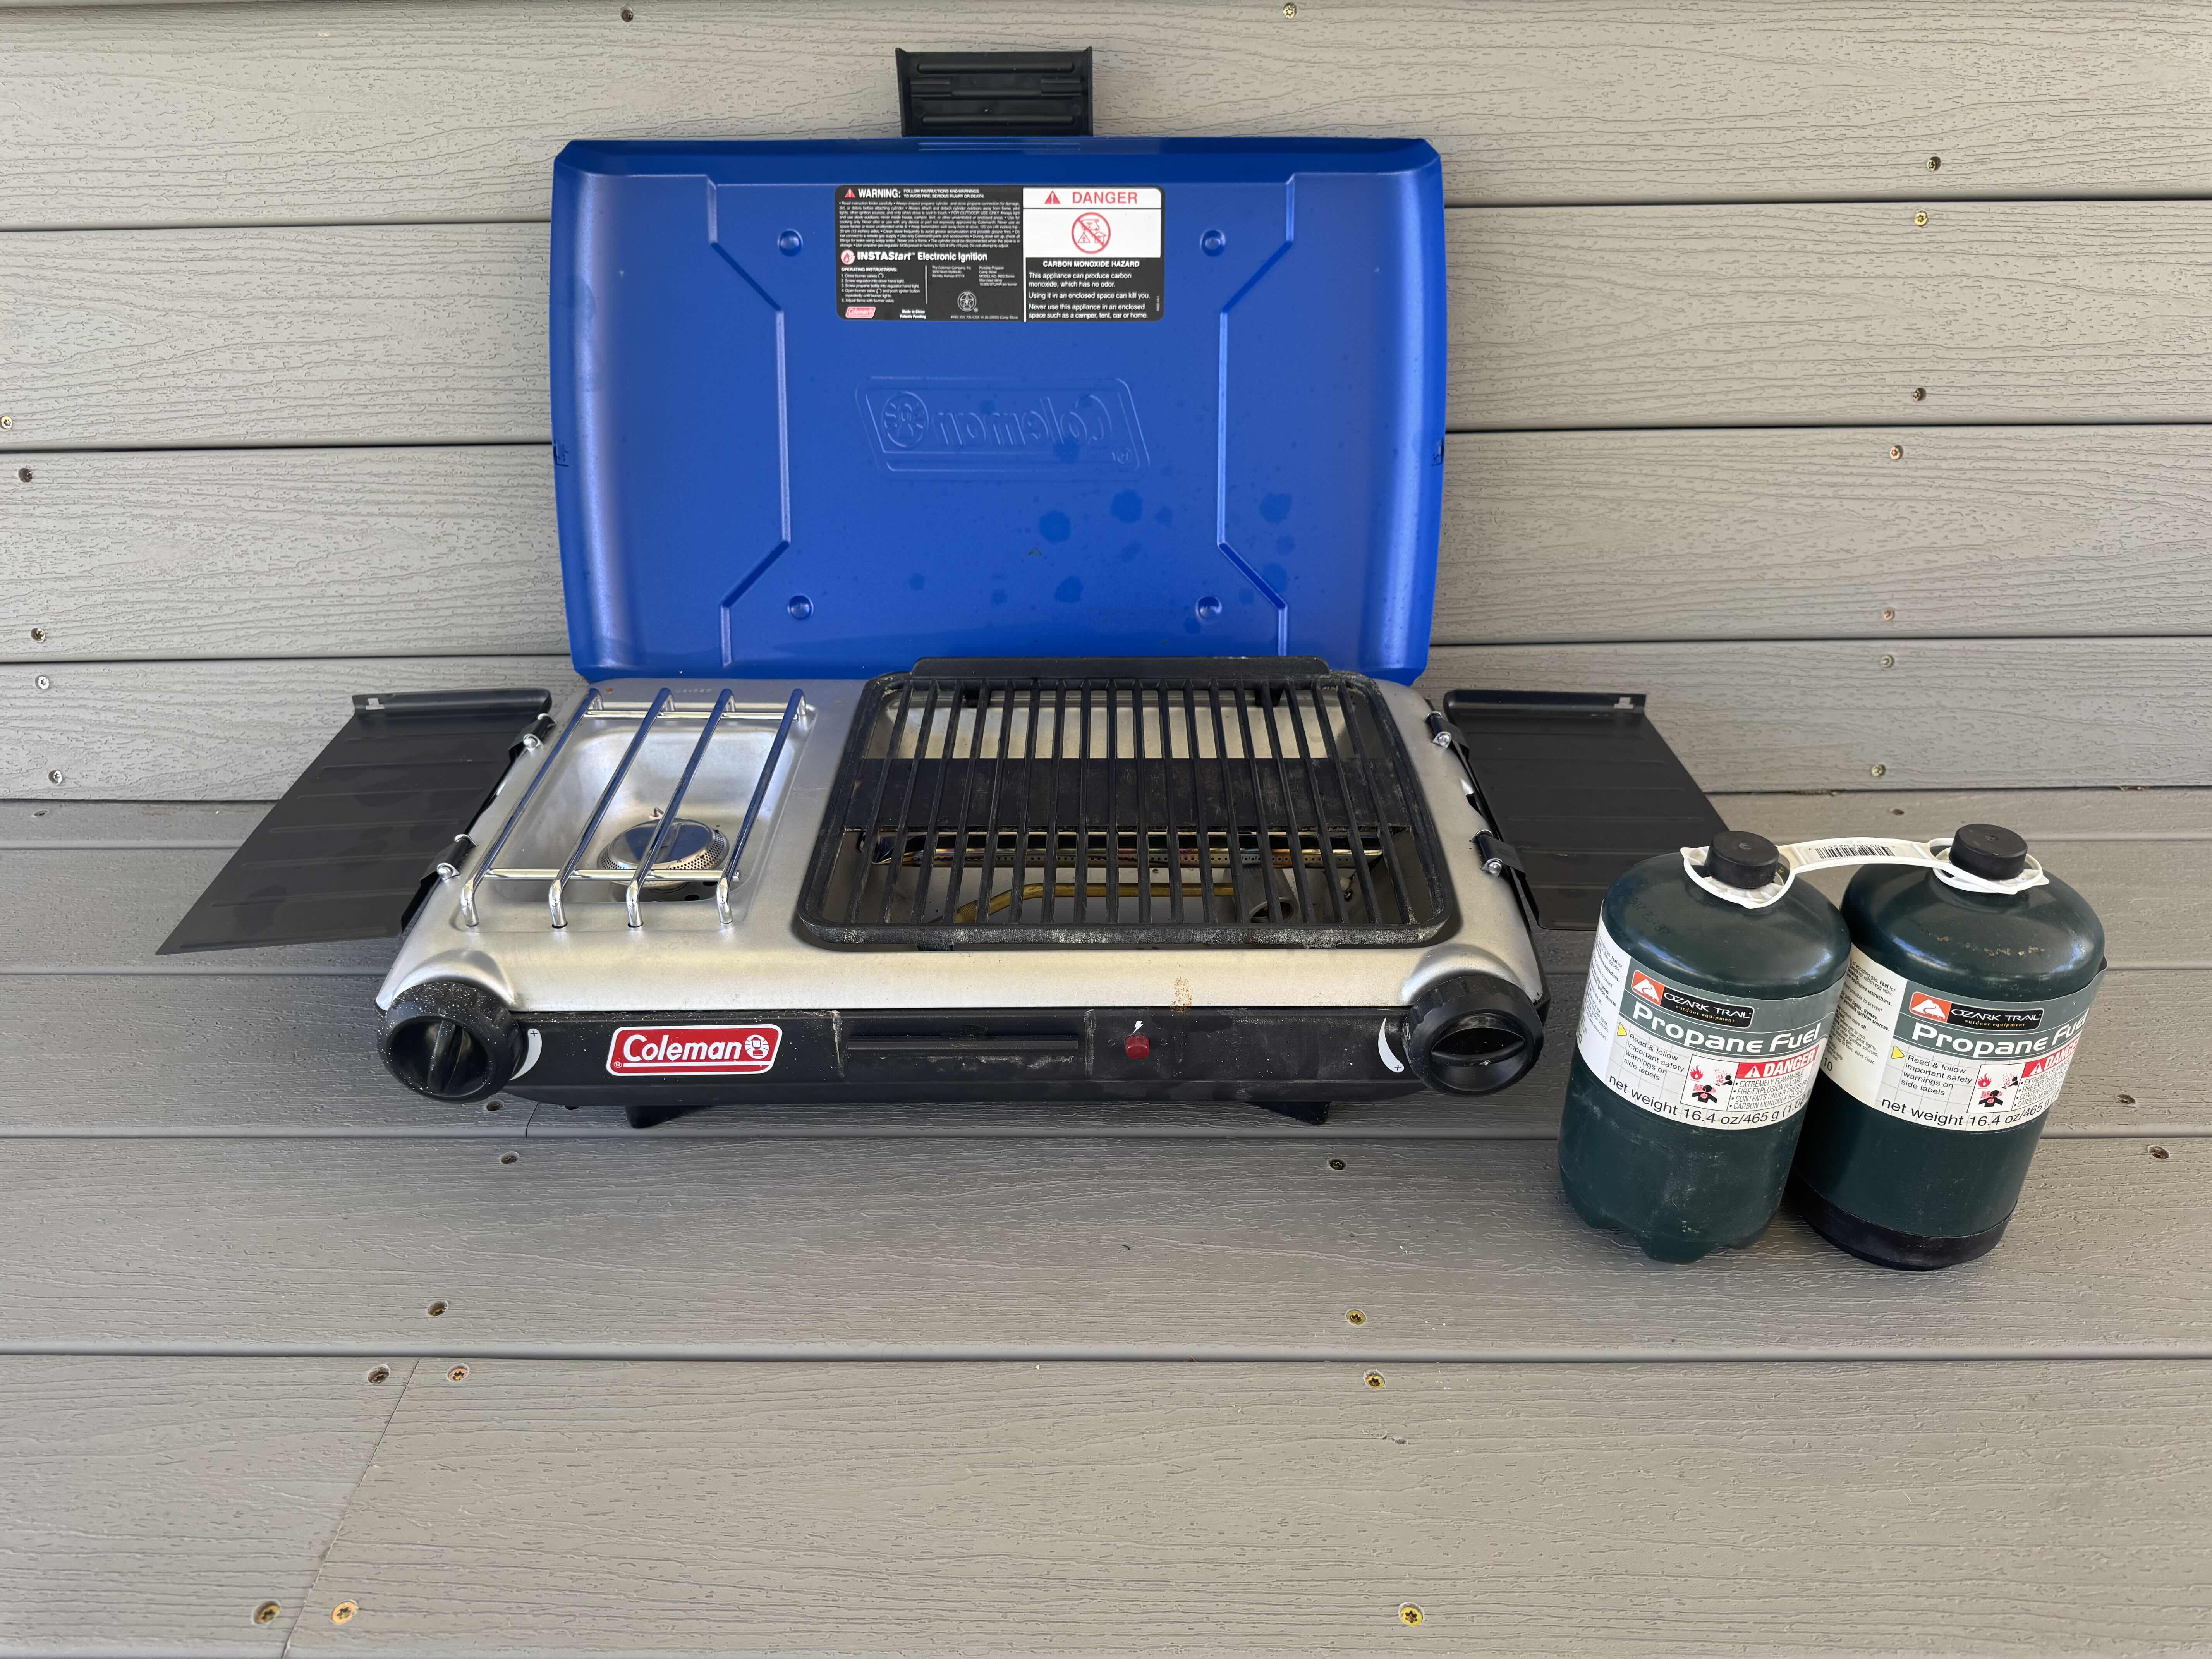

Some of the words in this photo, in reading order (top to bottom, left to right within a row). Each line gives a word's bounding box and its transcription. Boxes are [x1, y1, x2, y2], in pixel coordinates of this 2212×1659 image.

[859, 189, 901, 198] WARNING:
[1072, 192, 1137, 204] DANGER
[918, 252, 957, 261] Electronic
[958, 252, 988, 263] Ignition
[1664, 993, 1709, 1012] OZARK
[1713, 1007, 1752, 1019] TRAIL
[1868, 989, 1892, 1006] instructions.
[1675, 1005, 1699, 1015] outdoor
[1702, 1012, 1736, 1023] equipment
[1951, 1009, 2001, 1021] OZARK
[1633, 1001, 1764, 1053] Propane
[1769, 1025, 1821, 1052] Fuel
[1912, 1022, 2049, 1058] Propane
[2051, 1007, 2090, 1046] Fuel
[623, 1034, 742, 1062] Coleman
[1627, 1042, 1659, 1063] important
[1661, 1060, 1685, 1073] safety
[1629, 1034, 1647, 1048] Read
[1656, 1048, 1678, 1061] follow
[1624, 1058, 1637, 1070] side
[1639, 1066, 1660, 1081] labels
[1626, 1050, 1656, 1070] warnings
[1658, 1068, 1667, 1076] on
[1763, 1048, 1816, 1077] DANGER
[1908, 1055, 1930, 1066] Read
[1941, 1063, 1966, 1074] follow
[1740, 1079, 1774, 1087] EXTREMELY
[1775, 1068, 1804, 1085] FLAMMABLE
[1903, 1072, 1941, 1088] warnings
[1905, 1063, 1945, 1079] important
[1947, 1073, 1973, 1084] safety
[1737, 1083, 1784, 1095] FIRE/EXPLOSION
[1784, 1075, 1803, 1090] HAZARD
[1901, 1079, 1918, 1089] side
[1920, 1084, 1946, 1096] labels
[1609, 1075, 1628, 1094] net
[1631, 1089, 1678, 1116] weight
[1684, 1108, 1716, 1123] 16.4
[1721, 1111, 1769, 1124] oz/465
[1771, 1110, 1779, 1121] g
[1733, 1101, 1759, 1109] CARBON
[1760, 1095, 1789, 1108] MONOXIDE
[1735, 1094, 1767, 1102] CONTENTS
[1768, 1089, 1786, 1100] UNDER
[1881, 1098, 1906, 1114] net
[1911, 1109, 1964, 1126] weight
[1970, 1115, 2001, 1127] 16.4
[2005, 1105, 2043, 1125] oz/465
